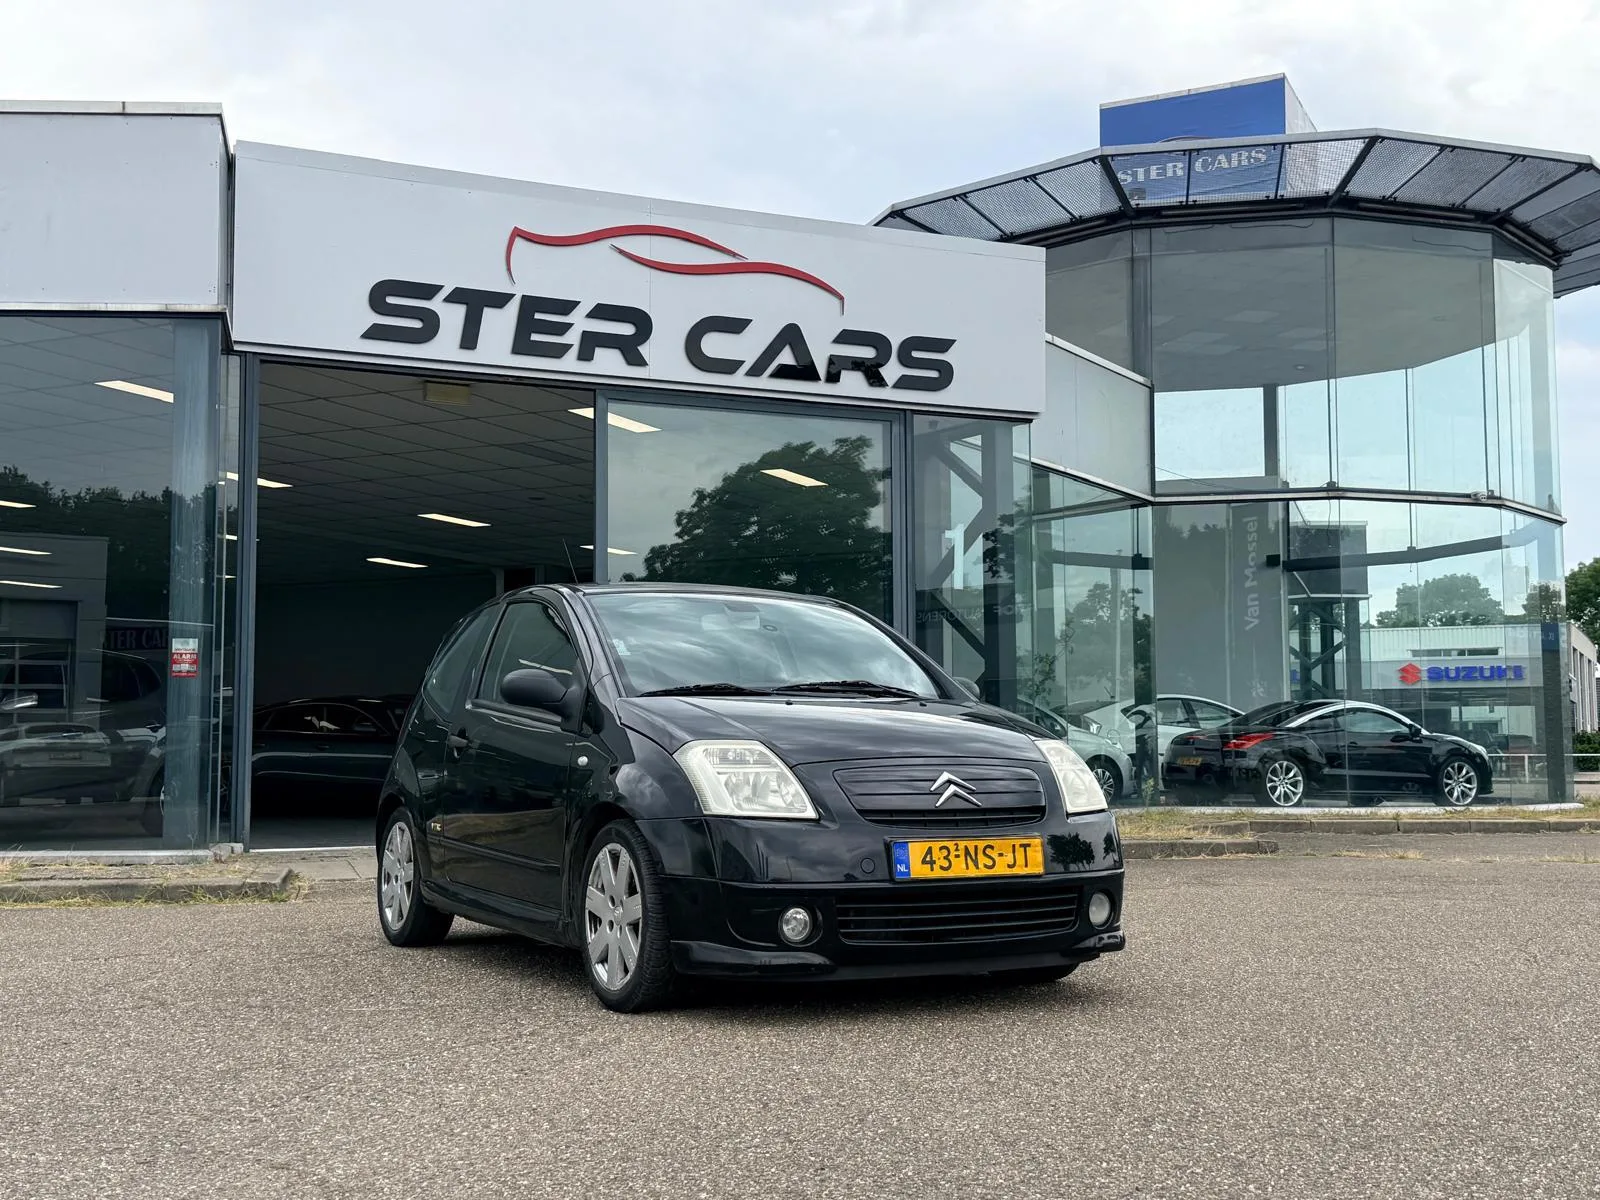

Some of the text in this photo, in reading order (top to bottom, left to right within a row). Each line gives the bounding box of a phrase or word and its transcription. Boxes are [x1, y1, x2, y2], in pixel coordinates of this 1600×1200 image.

[1117, 148, 1267, 185] STER CARS
[361, 279, 957, 392] STER CARS
[1243, 516, 1259, 631] Van Mossel
[101, 630, 137, 649] TER
[1427, 665, 1526, 681] SUZUKI
[897, 864, 908, 872] NL
[921, 843, 1031, 872] 43-NS-JT
